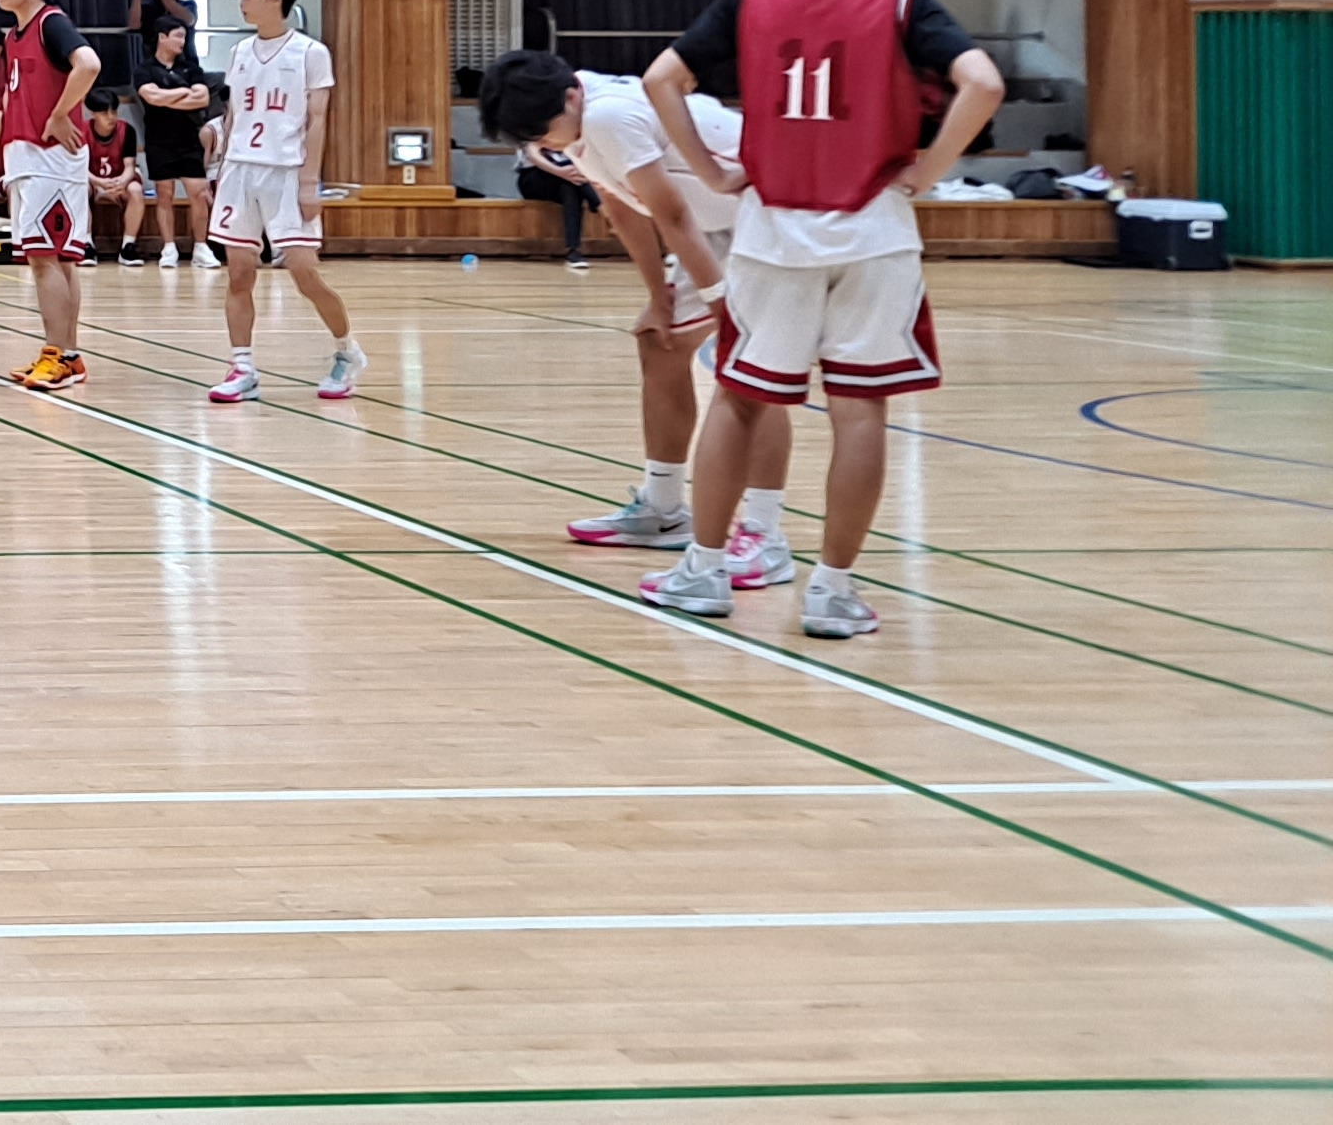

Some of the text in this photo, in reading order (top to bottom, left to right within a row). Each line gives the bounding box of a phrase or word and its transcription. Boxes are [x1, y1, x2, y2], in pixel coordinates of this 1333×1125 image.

[780, 56, 835, 121] 11
[249, 122, 264, 148] 2
[99, 156, 112, 176] 5
[219, 205, 233, 229] 2
